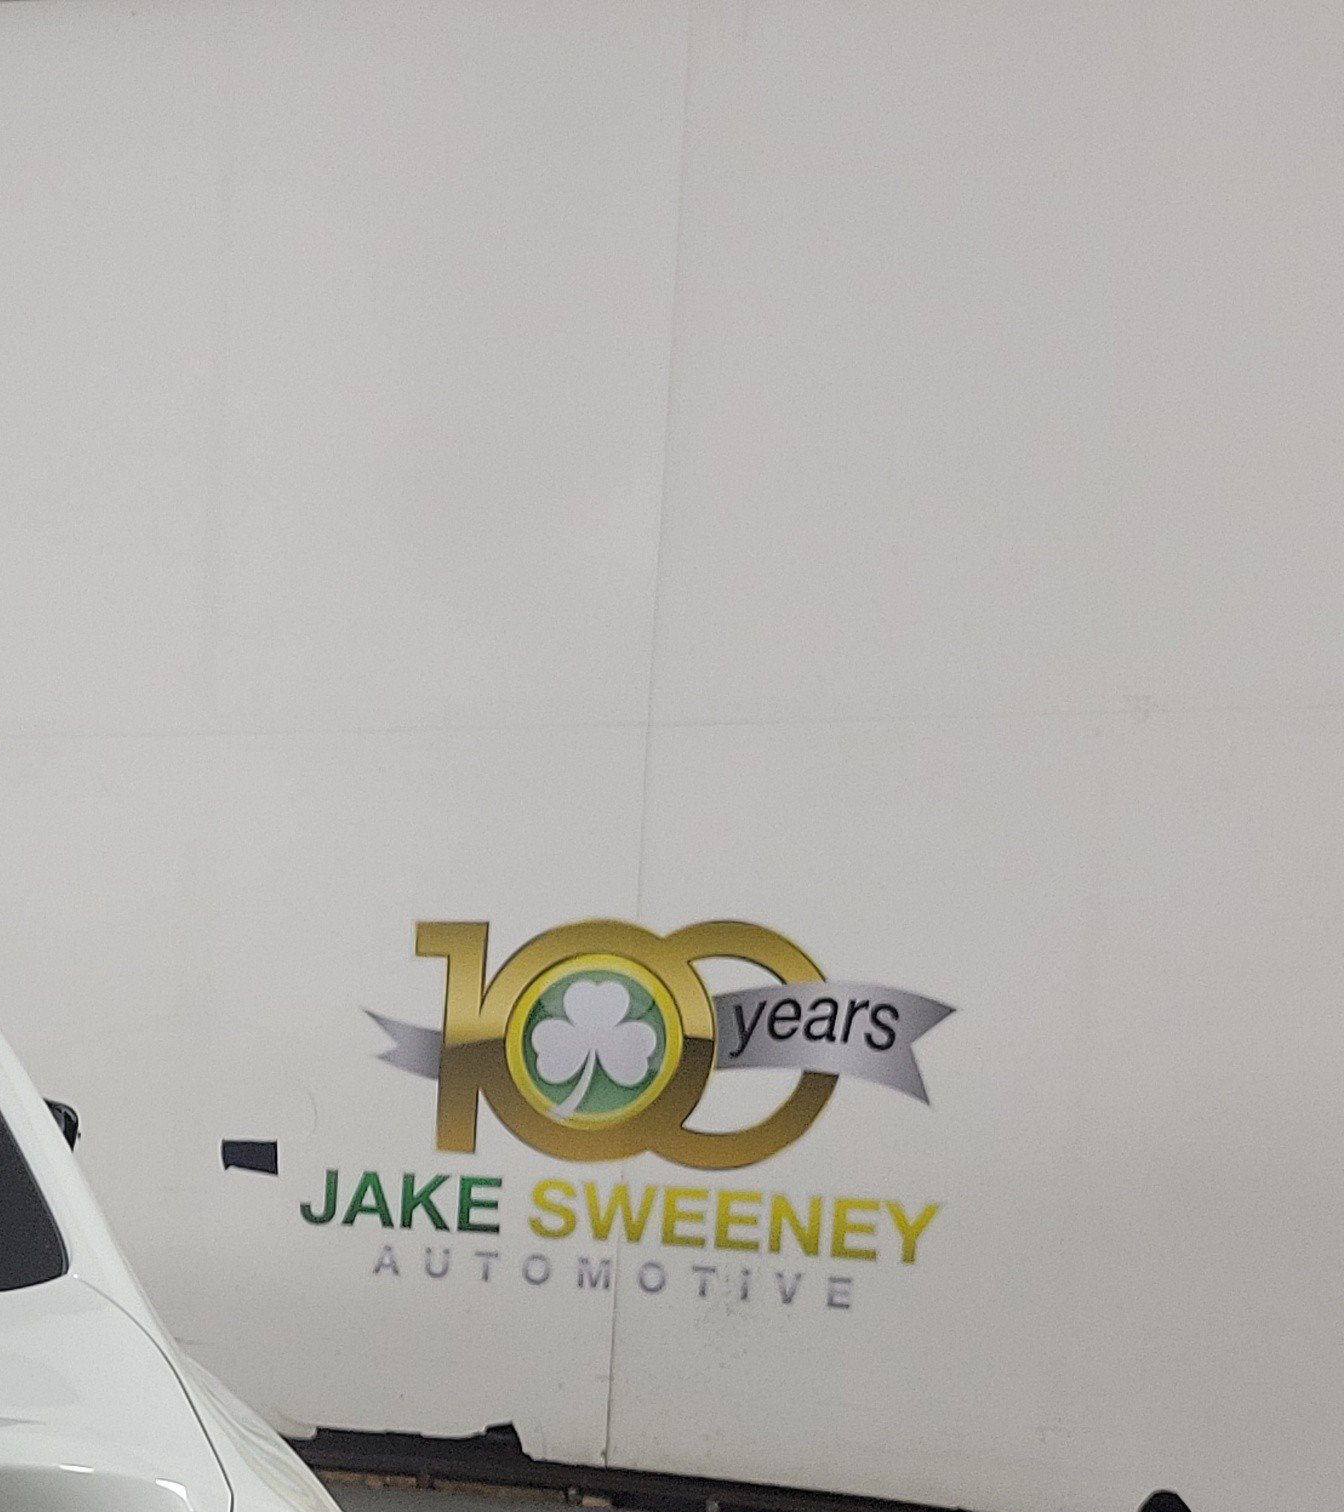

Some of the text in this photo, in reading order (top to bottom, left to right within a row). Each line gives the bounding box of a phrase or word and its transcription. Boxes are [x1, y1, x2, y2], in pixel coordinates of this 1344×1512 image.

[729, 995, 900, 1059] years
[299, 1169, 940, 1265] JAKE SWEENEY
[373, 1245, 854, 1311] AUTOMOTIVE
